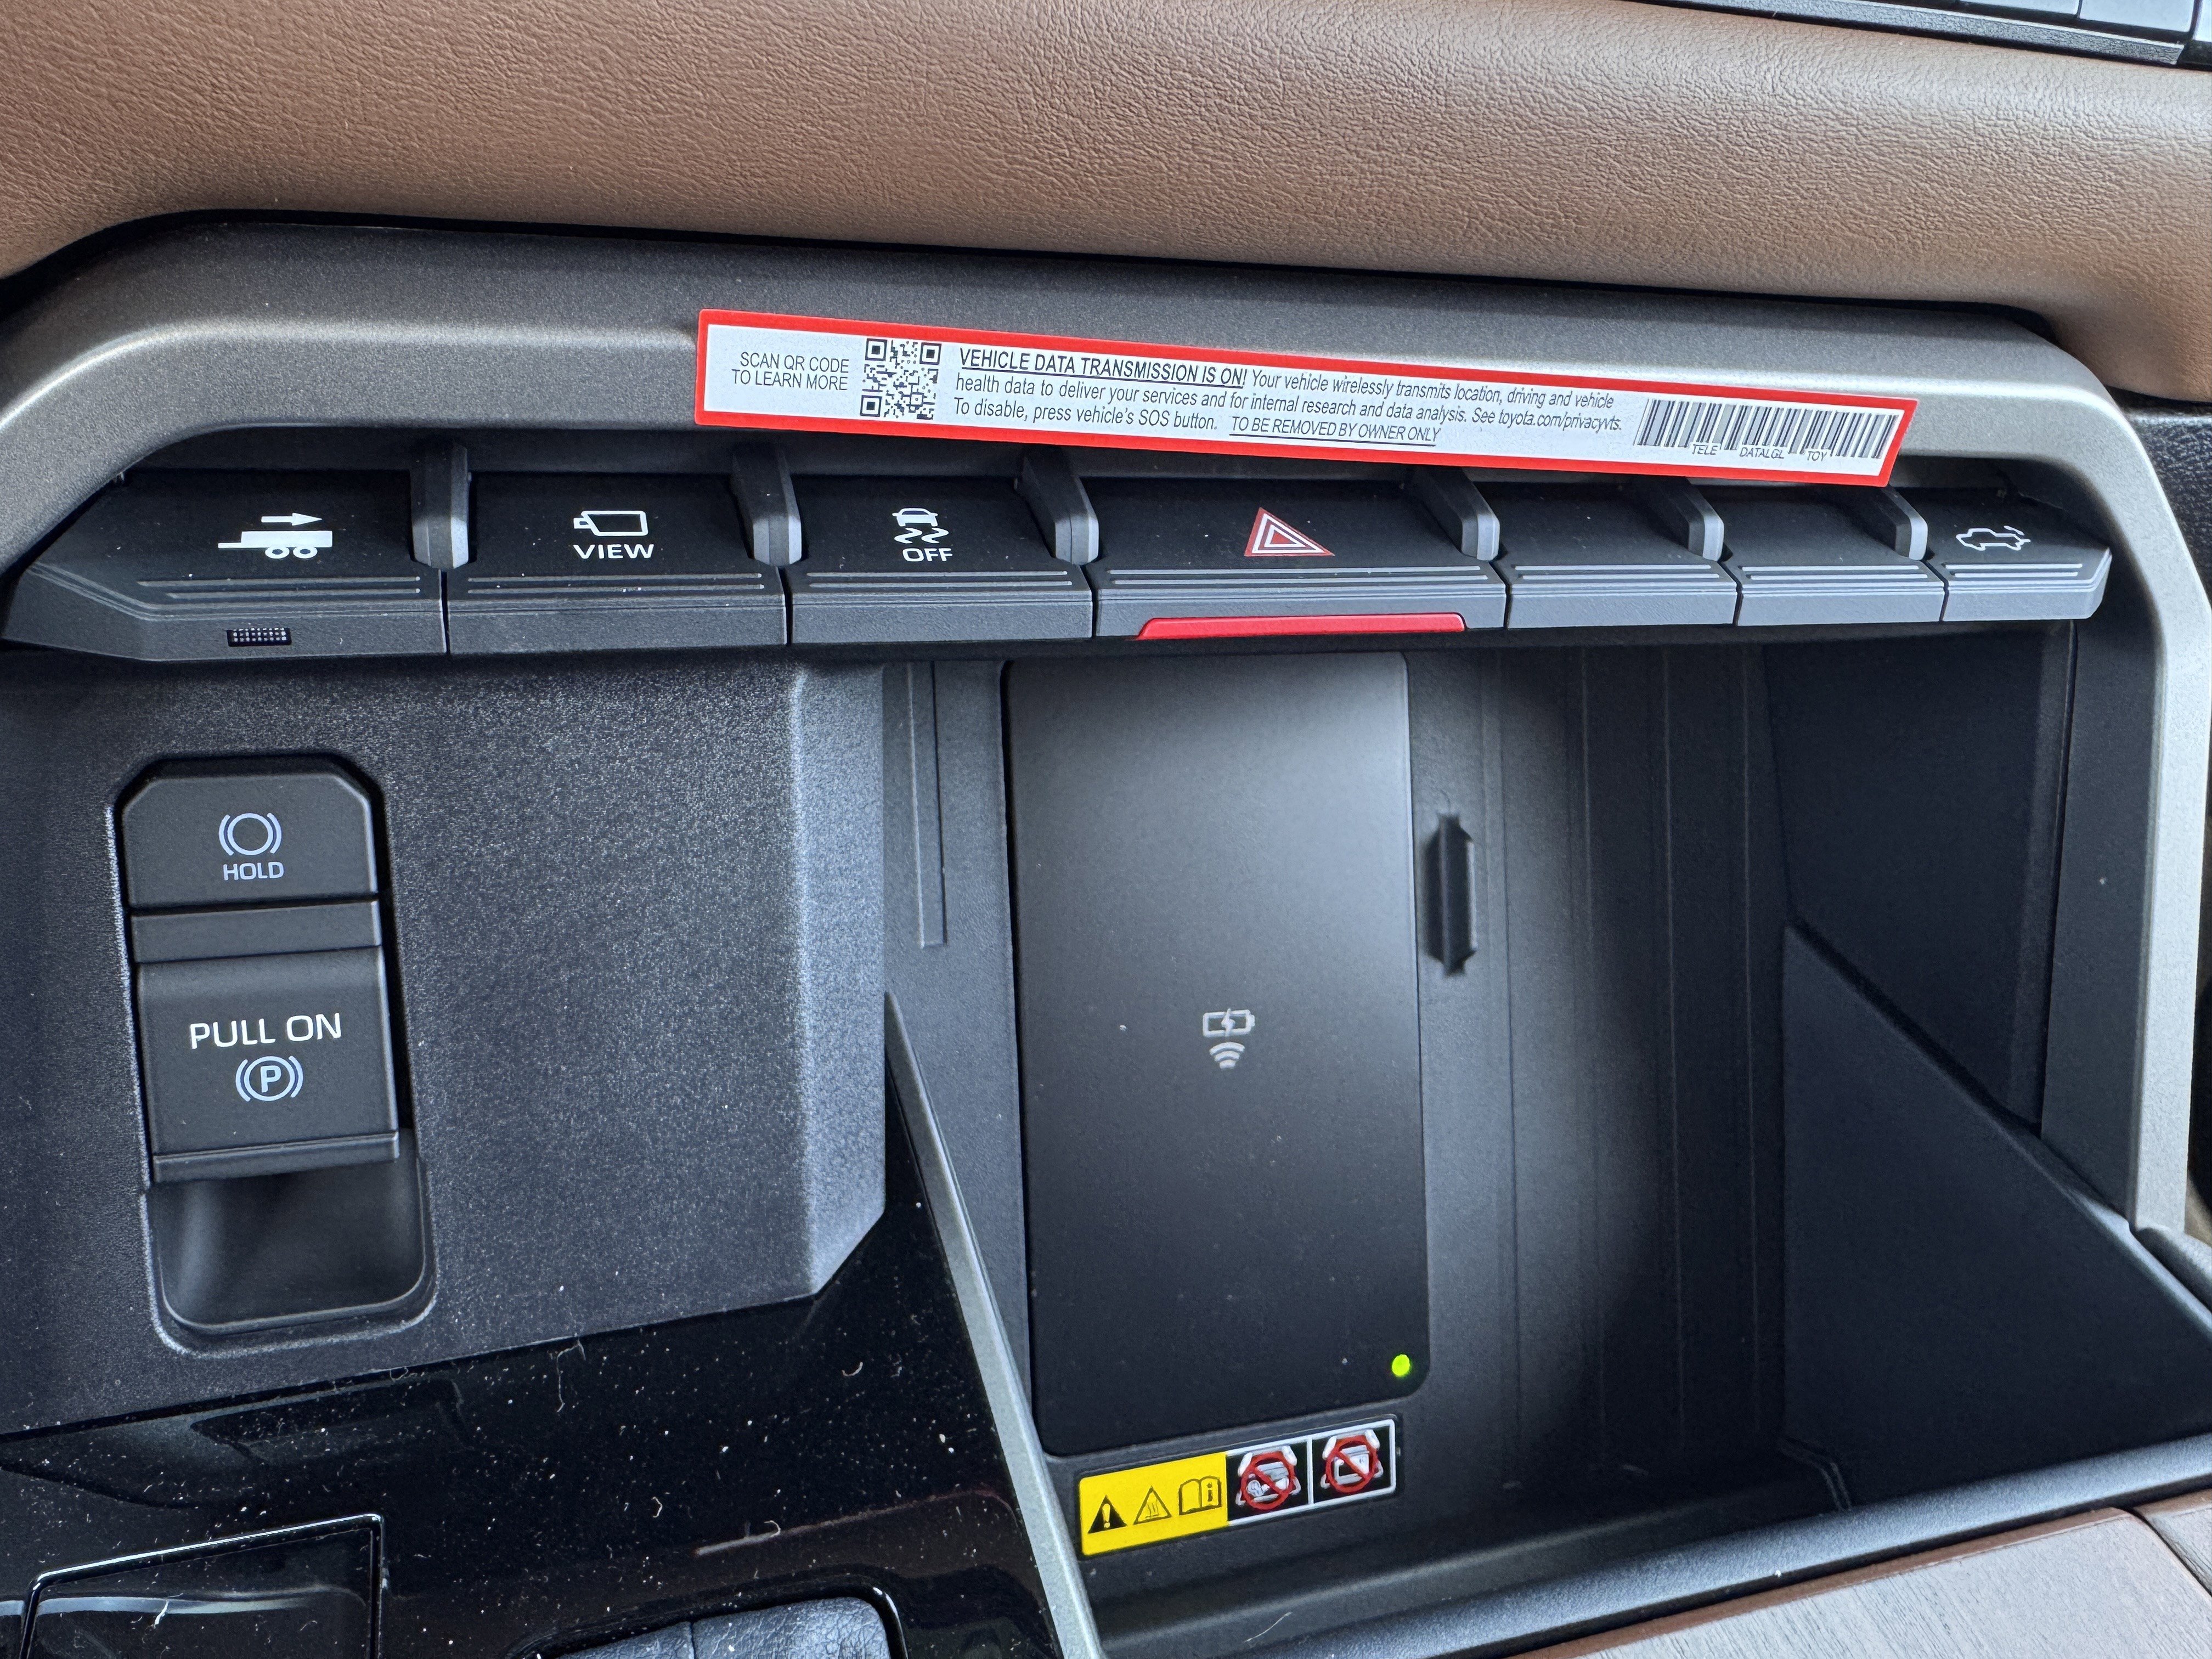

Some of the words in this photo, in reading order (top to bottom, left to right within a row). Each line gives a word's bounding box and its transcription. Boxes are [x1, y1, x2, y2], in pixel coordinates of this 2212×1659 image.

[740, 352, 780, 369] SCAN
[784, 357, 804, 371] QR
[809, 358, 849, 374] CODE
[732, 369, 752, 385] TO
[755, 371, 802, 388] LEARN
[806, 375, 848, 391] MORE
[960, 348, 1030, 370] VEHICLE
[1034, 354, 1075, 374] DATA
[1081, 357, 1199, 382] TRANSMISSION
[1202, 365, 1216, 383] IS
[1252, 369, 1282, 388] Your
[1285, 373, 1328, 391] vehicle
[1333, 375, 1394, 399] wirelessly
[1396, 380, 1452, 399] transmits
[1454, 383, 1502, 405] location,
[1508, 387, 1546, 409] driving
[1549, 391, 1573, 406] and
[1575, 392, 1614, 409] vehicle
[956, 373, 999, 393] health
[1005, 376, 1035, 395] data
[1041, 379, 1053, 396] to
[1059, 380, 1105, 400] deliver
[1108, 387, 1139, 405] your
[1142, 387, 1198, 405] services
[1201, 391, 1227, 408] and
[1229, 391, 1249, 409] for
[1251, 393, 1299, 412] internal
[1301, 399, 1357, 416] research
[1359, 402, 1384, 417] and
[1386, 402, 1413, 419] data
[1416, 405, 1467, 425] analysis.
[1472, 407, 1496, 424] See
[954, 397, 969, 415] To
[974, 399, 1028, 421] disable,
[1033, 407, 1071, 424] press
[1138, 409, 1170, 427] SOS
[1173, 411, 1217, 430] button.
[1232, 416, 1249, 431] TO
[1251, 417, 1271, 432] BE
[1272, 419, 1336, 436] REMOVED
[1339, 422, 1358, 437] BY
[1358, 424, 1406, 440] OWNER
[1408, 426, 1441, 442] ONLY
[1692, 444, 1718, 455] TELE
[1807, 450, 1828, 462] TOY
[573, 543, 654, 560] VIEW
[902, 548, 953, 562] OFF
[223, 861, 284, 881] HOLD
[189, 1018, 276, 1050] PULL
[286, 1012, 342, 1042] ON
